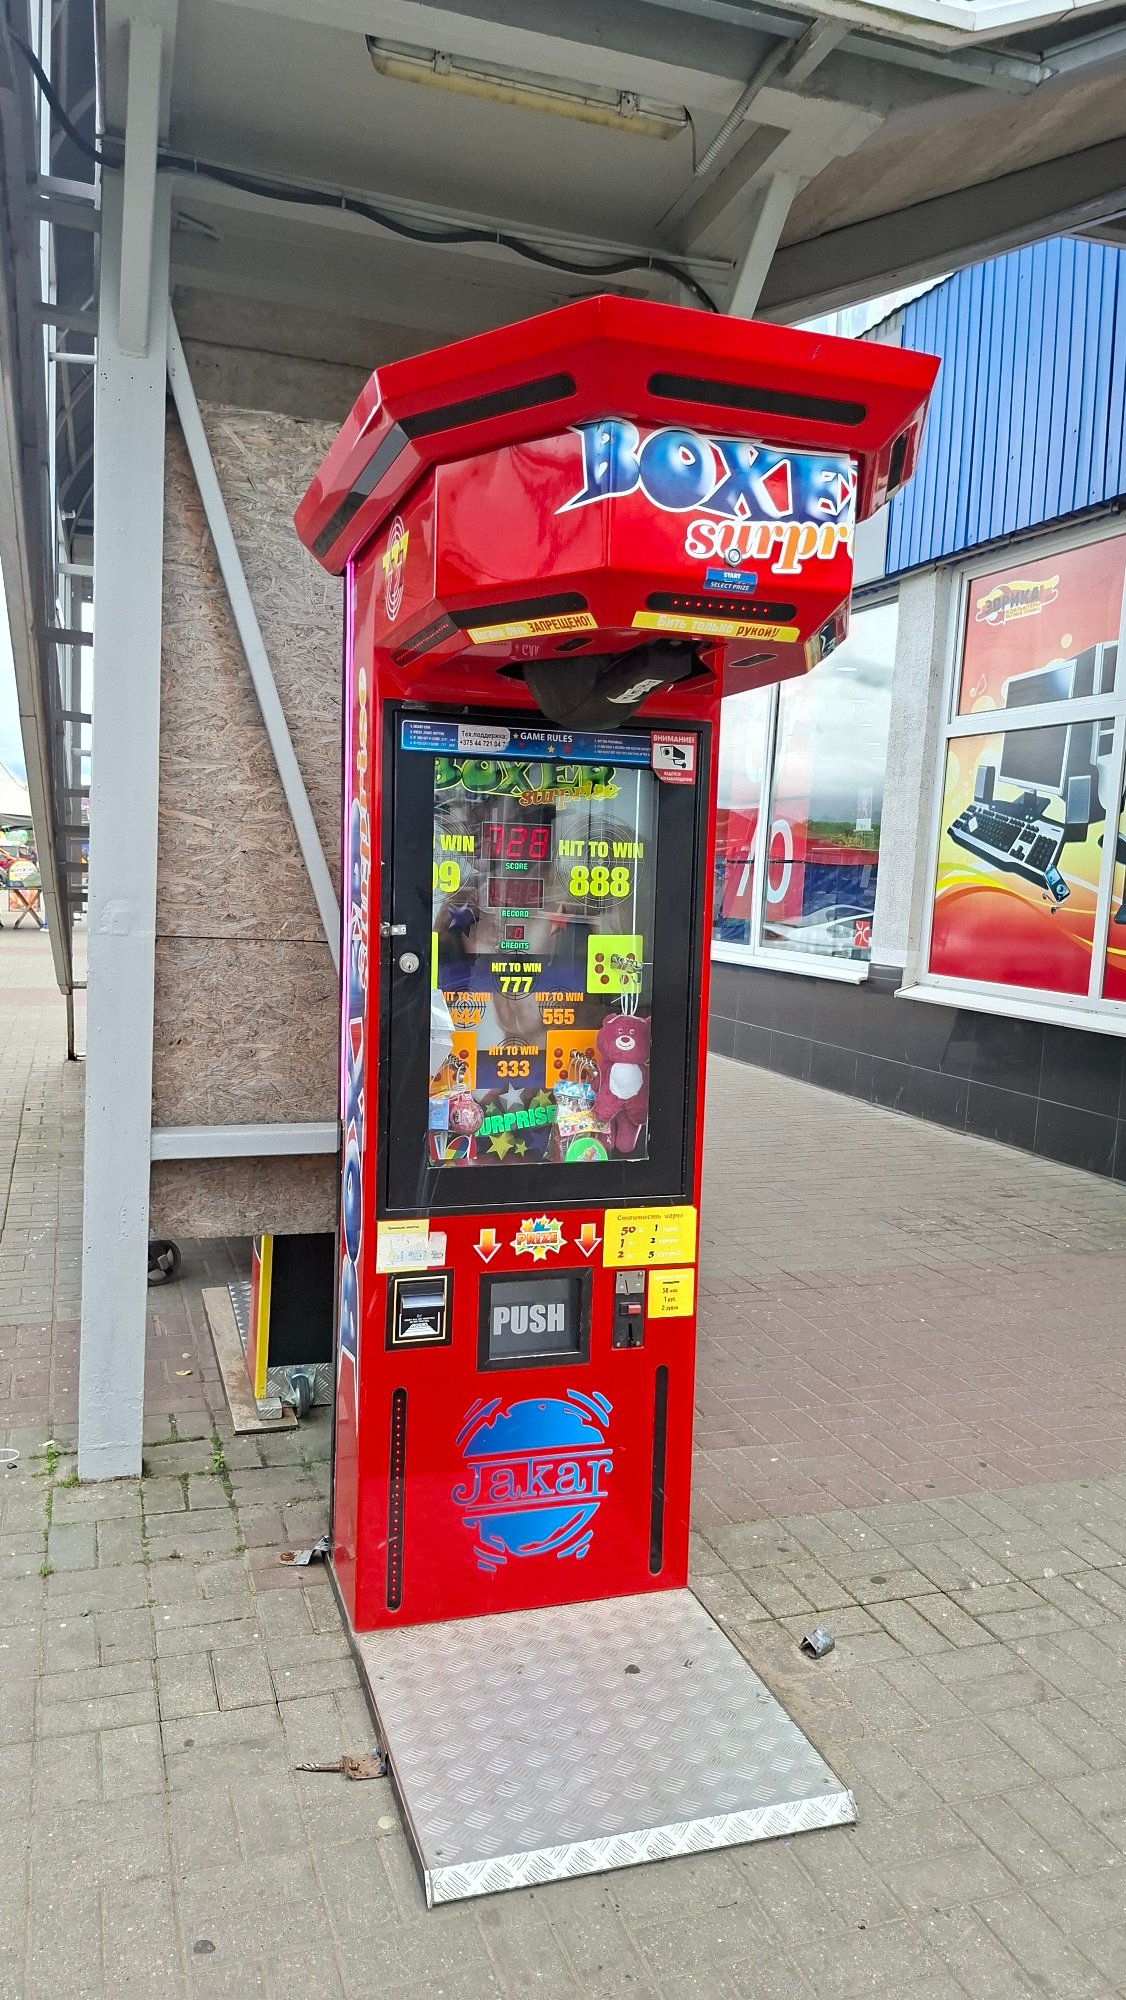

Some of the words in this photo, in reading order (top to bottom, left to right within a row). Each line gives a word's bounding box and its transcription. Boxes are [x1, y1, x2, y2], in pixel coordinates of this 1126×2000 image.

[554, 417, 858, 522] BOXE
[685, 519, 854, 574] surpr
[710, 581, 732, 589] SELECT
[472, 628, 504, 641] Ногами
[505, 624, 528, 636] бить
[527, 615, 592, 633] ЗАПРЕЩЕНО!
[656, 616, 687, 630] Бить
[691, 621, 734, 634] только
[520, 732, 545, 741] GAME
[547, 734, 573, 743] RULES
[653, 734, 695, 744] ВНИМАНИЕ!
[519, 781, 622, 810] surprise
[440, 834, 475, 852] WIN
[488, 826, 549, 859] 728
[559, 839, 585, 857] HIT
[588, 840, 609, 858] TO
[612, 841, 644, 859] WIN
[505, 862, 528, 870] SCORE
[433, 860, 461, 893] 9
[569, 865, 630, 897] 888
[501, 910, 529, 918] RECORD
[500, 941, 529, 949] CREDITS
[491, 962, 507, 972] HIT
[509, 962, 521, 972] TO
[523, 962, 542, 973] WIN
[499, 976, 533, 993] 777
[457, 992, 469, 1002] TO
[472, 992, 491, 1002] WIN
[535, 992, 551, 1002] HIT
[552, 992, 563, 1002] TO
[566, 992, 584, 1002] WIN
[542, 1008, 575, 1025] 555
[488, 1045, 504, 1055] HIT
[507, 1045, 518, 1055] TO
[520, 1045, 539, 1056] WIN
[497, 1060, 530, 1077] 333
[475, 1105, 557, 1137] URPRISE
[617, 1213, 662, 1221] Стоимость
[620, 1226, 636, 1236] 50
[654, 1224, 659, 1232] 1
[516, 1231, 558, 1246] PRIZE
[620, 1238, 625, 1248] 1
[617, 1251, 624, 1259] 2
[648, 1251, 655, 1259] 5
[493, 1303, 565, 1335] PUSH
[452, 1457, 613, 1508] Jakar
